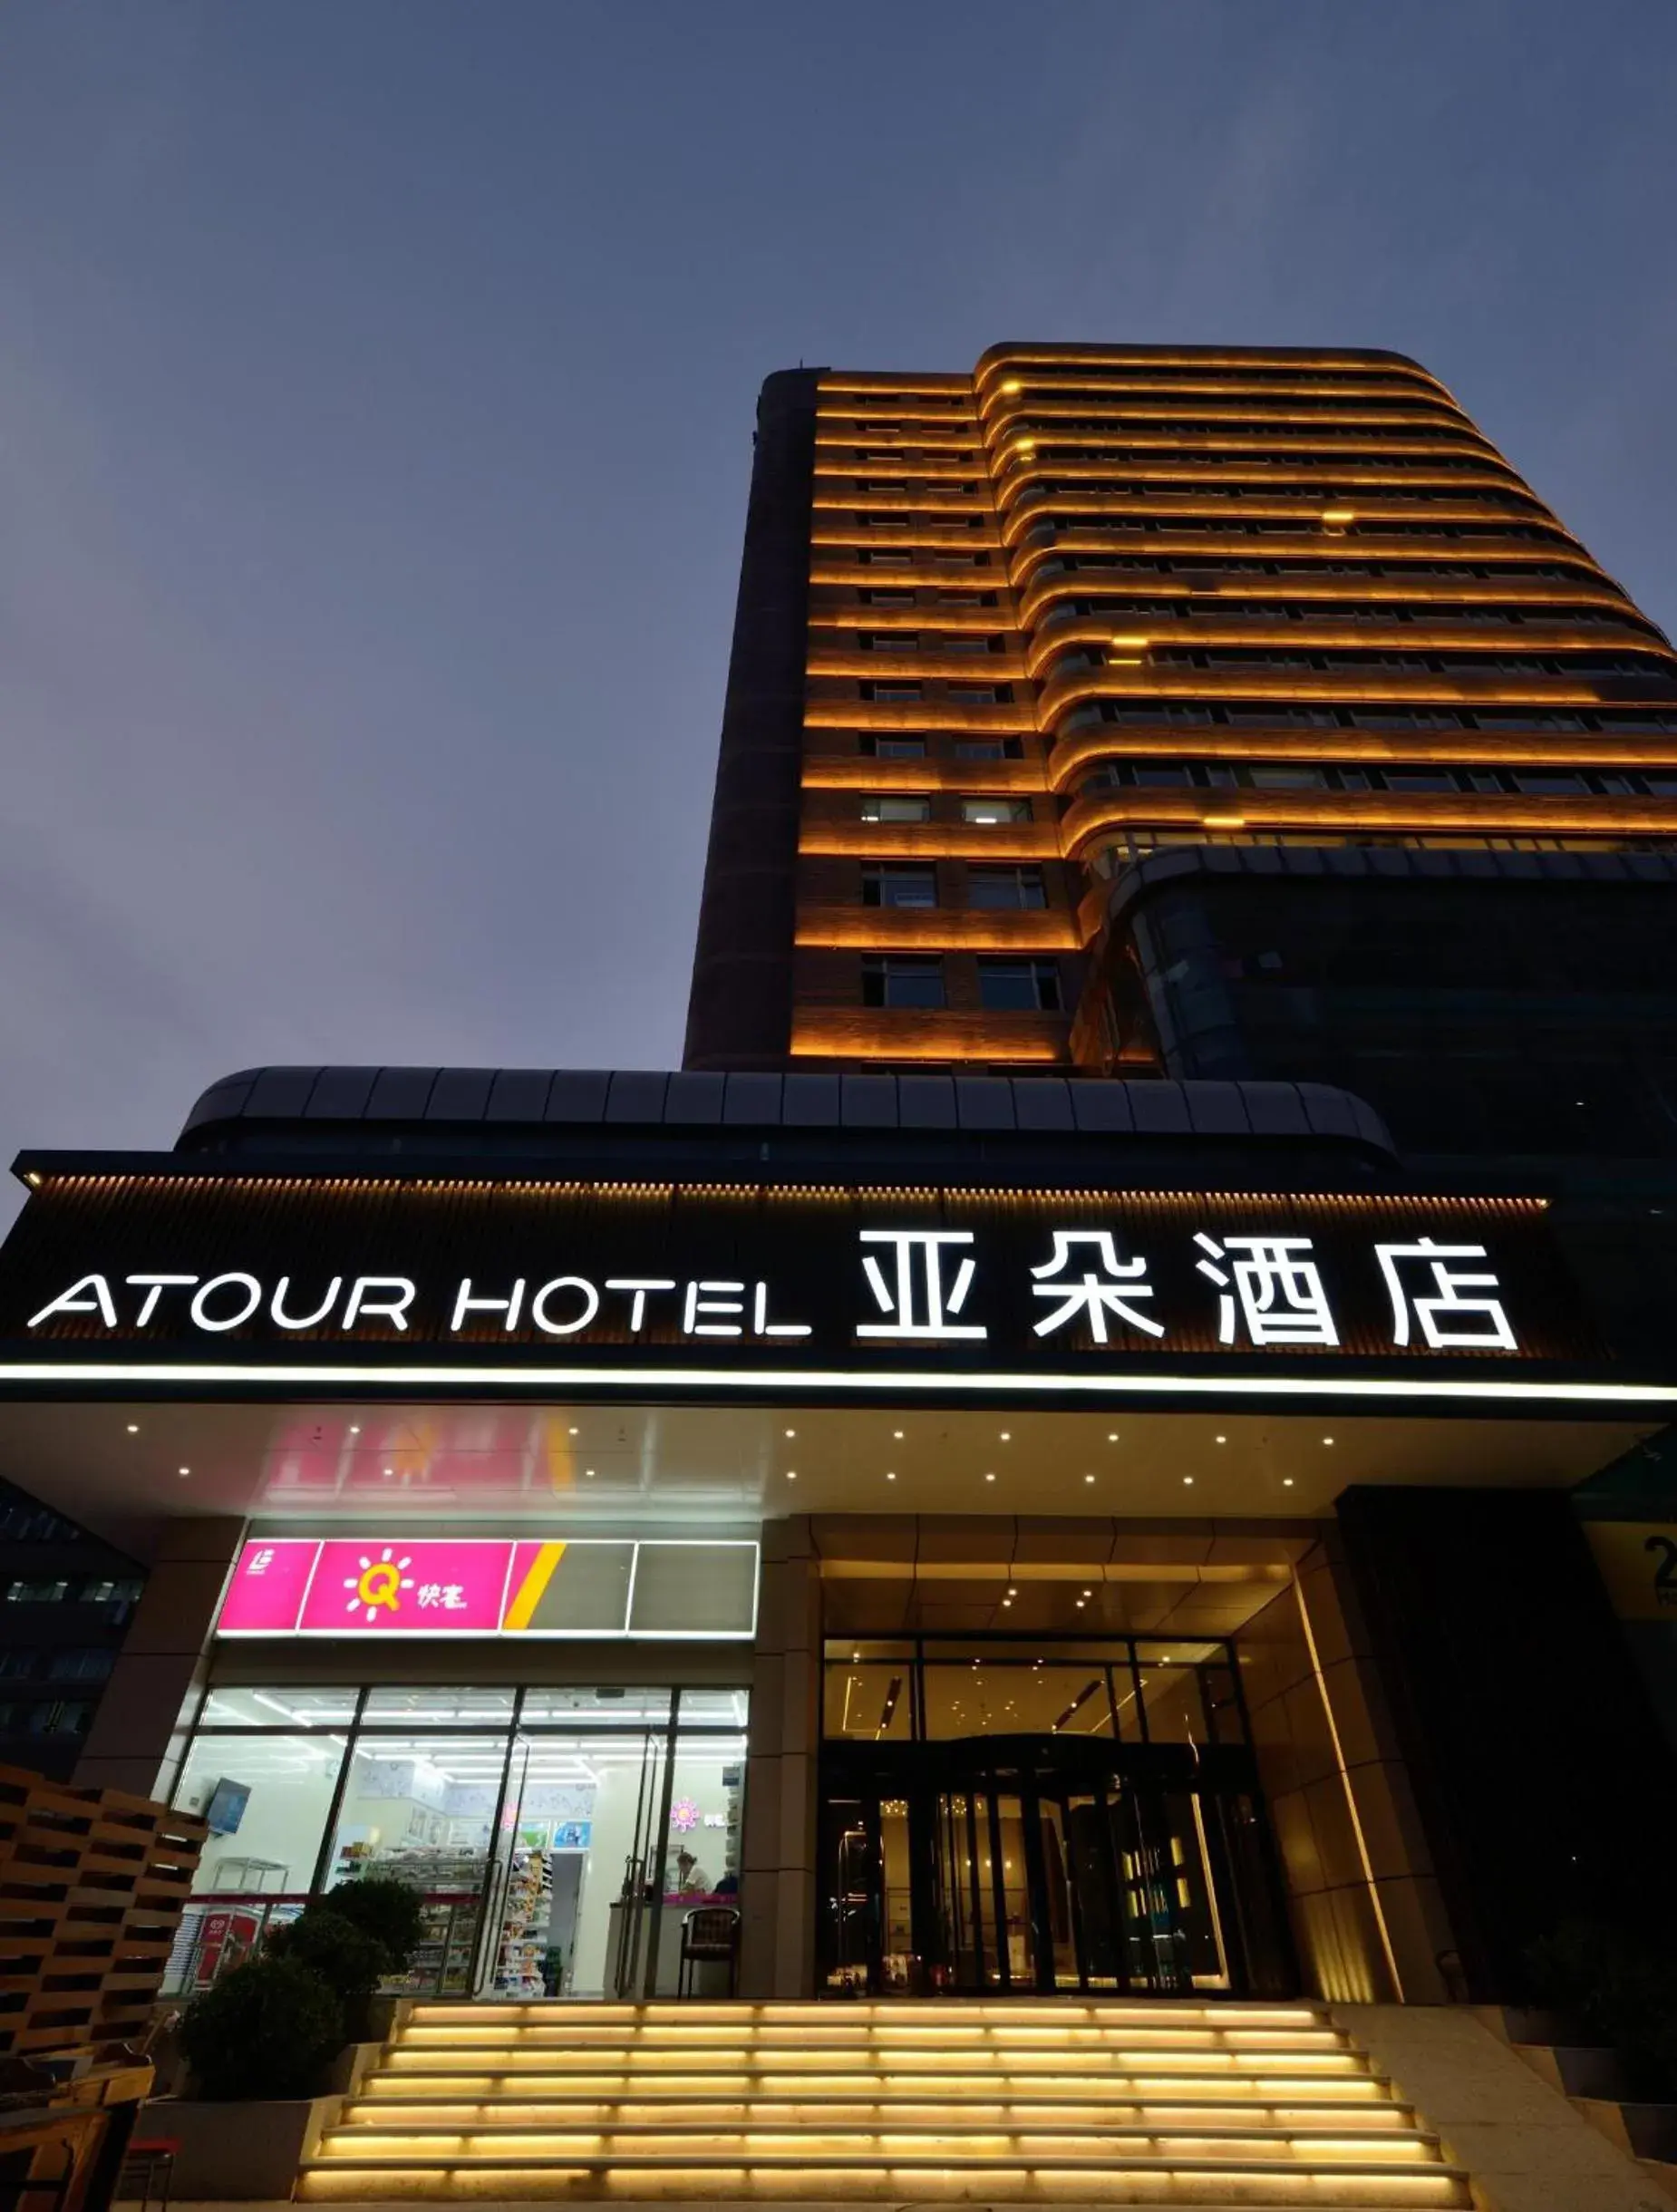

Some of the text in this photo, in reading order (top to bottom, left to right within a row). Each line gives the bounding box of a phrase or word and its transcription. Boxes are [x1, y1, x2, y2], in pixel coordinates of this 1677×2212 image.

[27, 1272, 812, 1336] ATOUR HOTEL
[857, 1230, 1518, 1350] 亚朵酒店
[359, 1564, 401, 1611] Q
[417, 1583, 468, 1610] 快客
